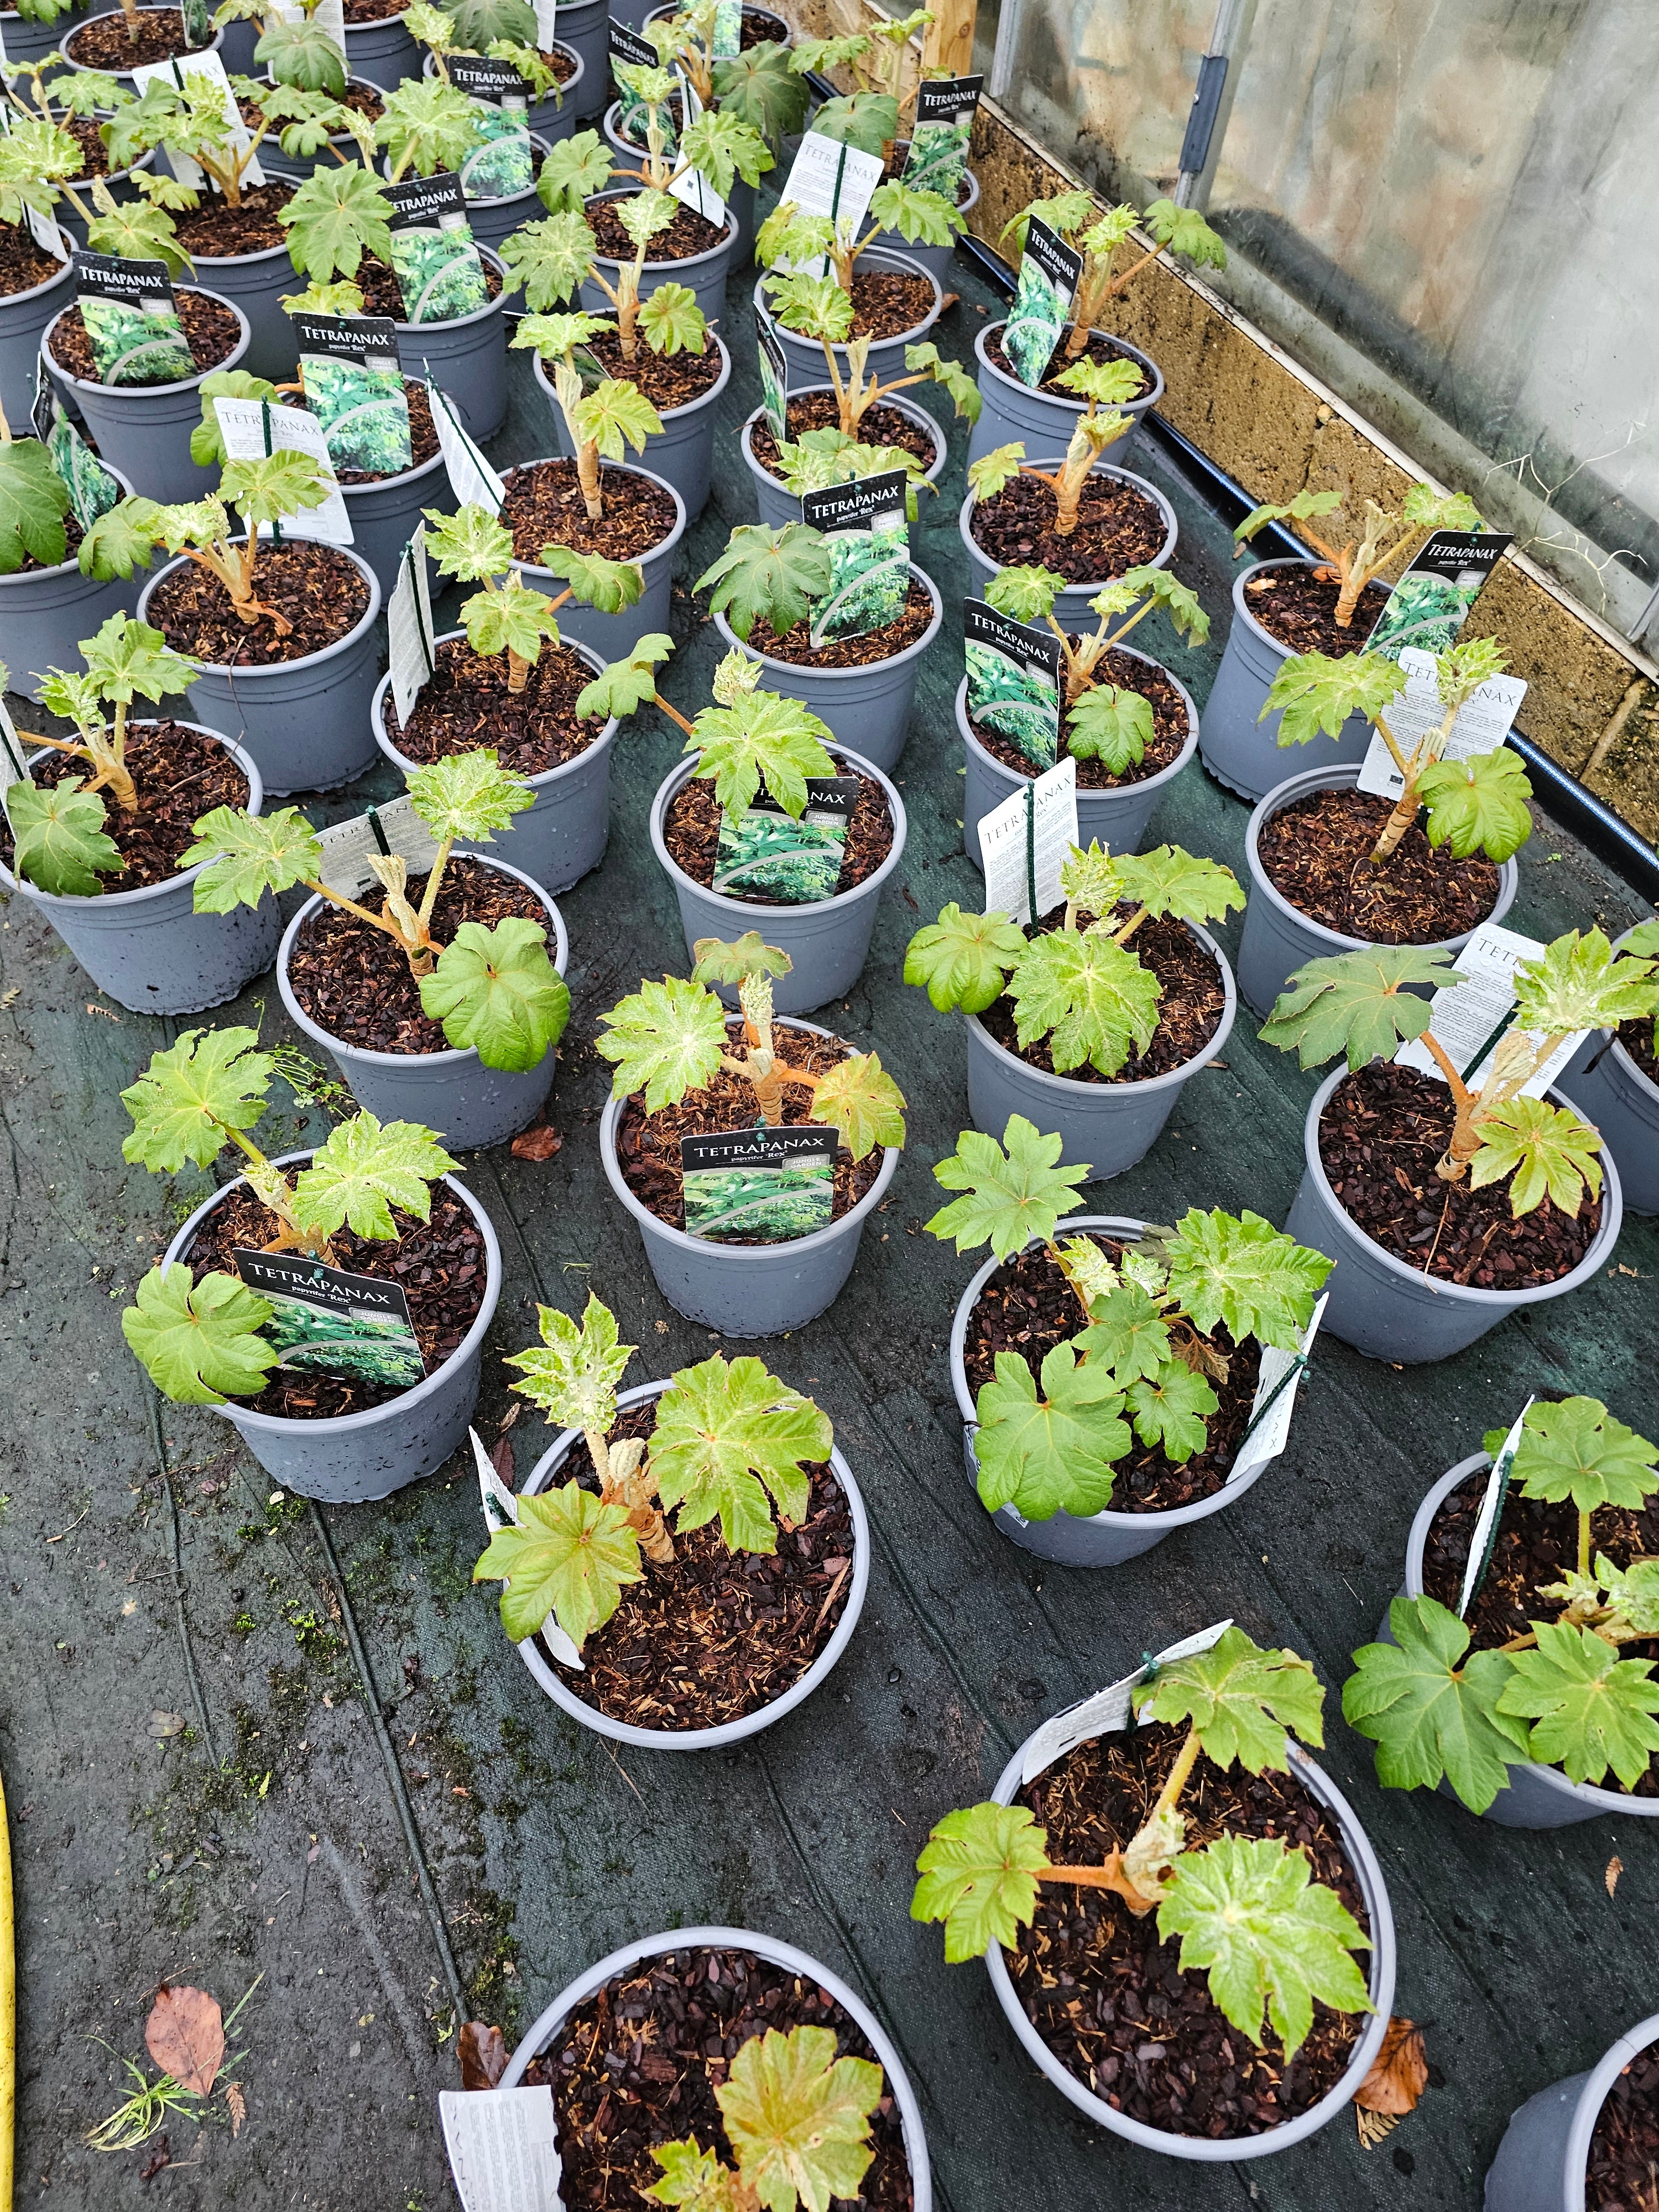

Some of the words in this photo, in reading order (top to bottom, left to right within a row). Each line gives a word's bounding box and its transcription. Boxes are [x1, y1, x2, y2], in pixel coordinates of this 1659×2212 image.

[454, 69, 523, 85] TETRAPANAX
[924, 90, 977, 106] TETRAPANAX
[805, 144, 878, 183] TETRAANAX
[1032, 228, 1075, 279] TETRAPANAX
[79, 265, 163, 288] TETRAPANAX
[301, 326, 389, 346] TETRAPANAX
[222, 412, 319, 436] TETRPANAX
[812, 485, 899, 519] TETRAPANAX
[1428, 544, 1498, 560] TETRAPANAX
[971, 613, 1050, 664] TETRAPANAX
[984, 774, 1071, 844] TETRAANAX
[694, 1138, 825, 1157] TETRAPANAX
[248, 1262, 390, 1304] TETRAPANAX
[291, 1285, 326, 1298] papyrifer
